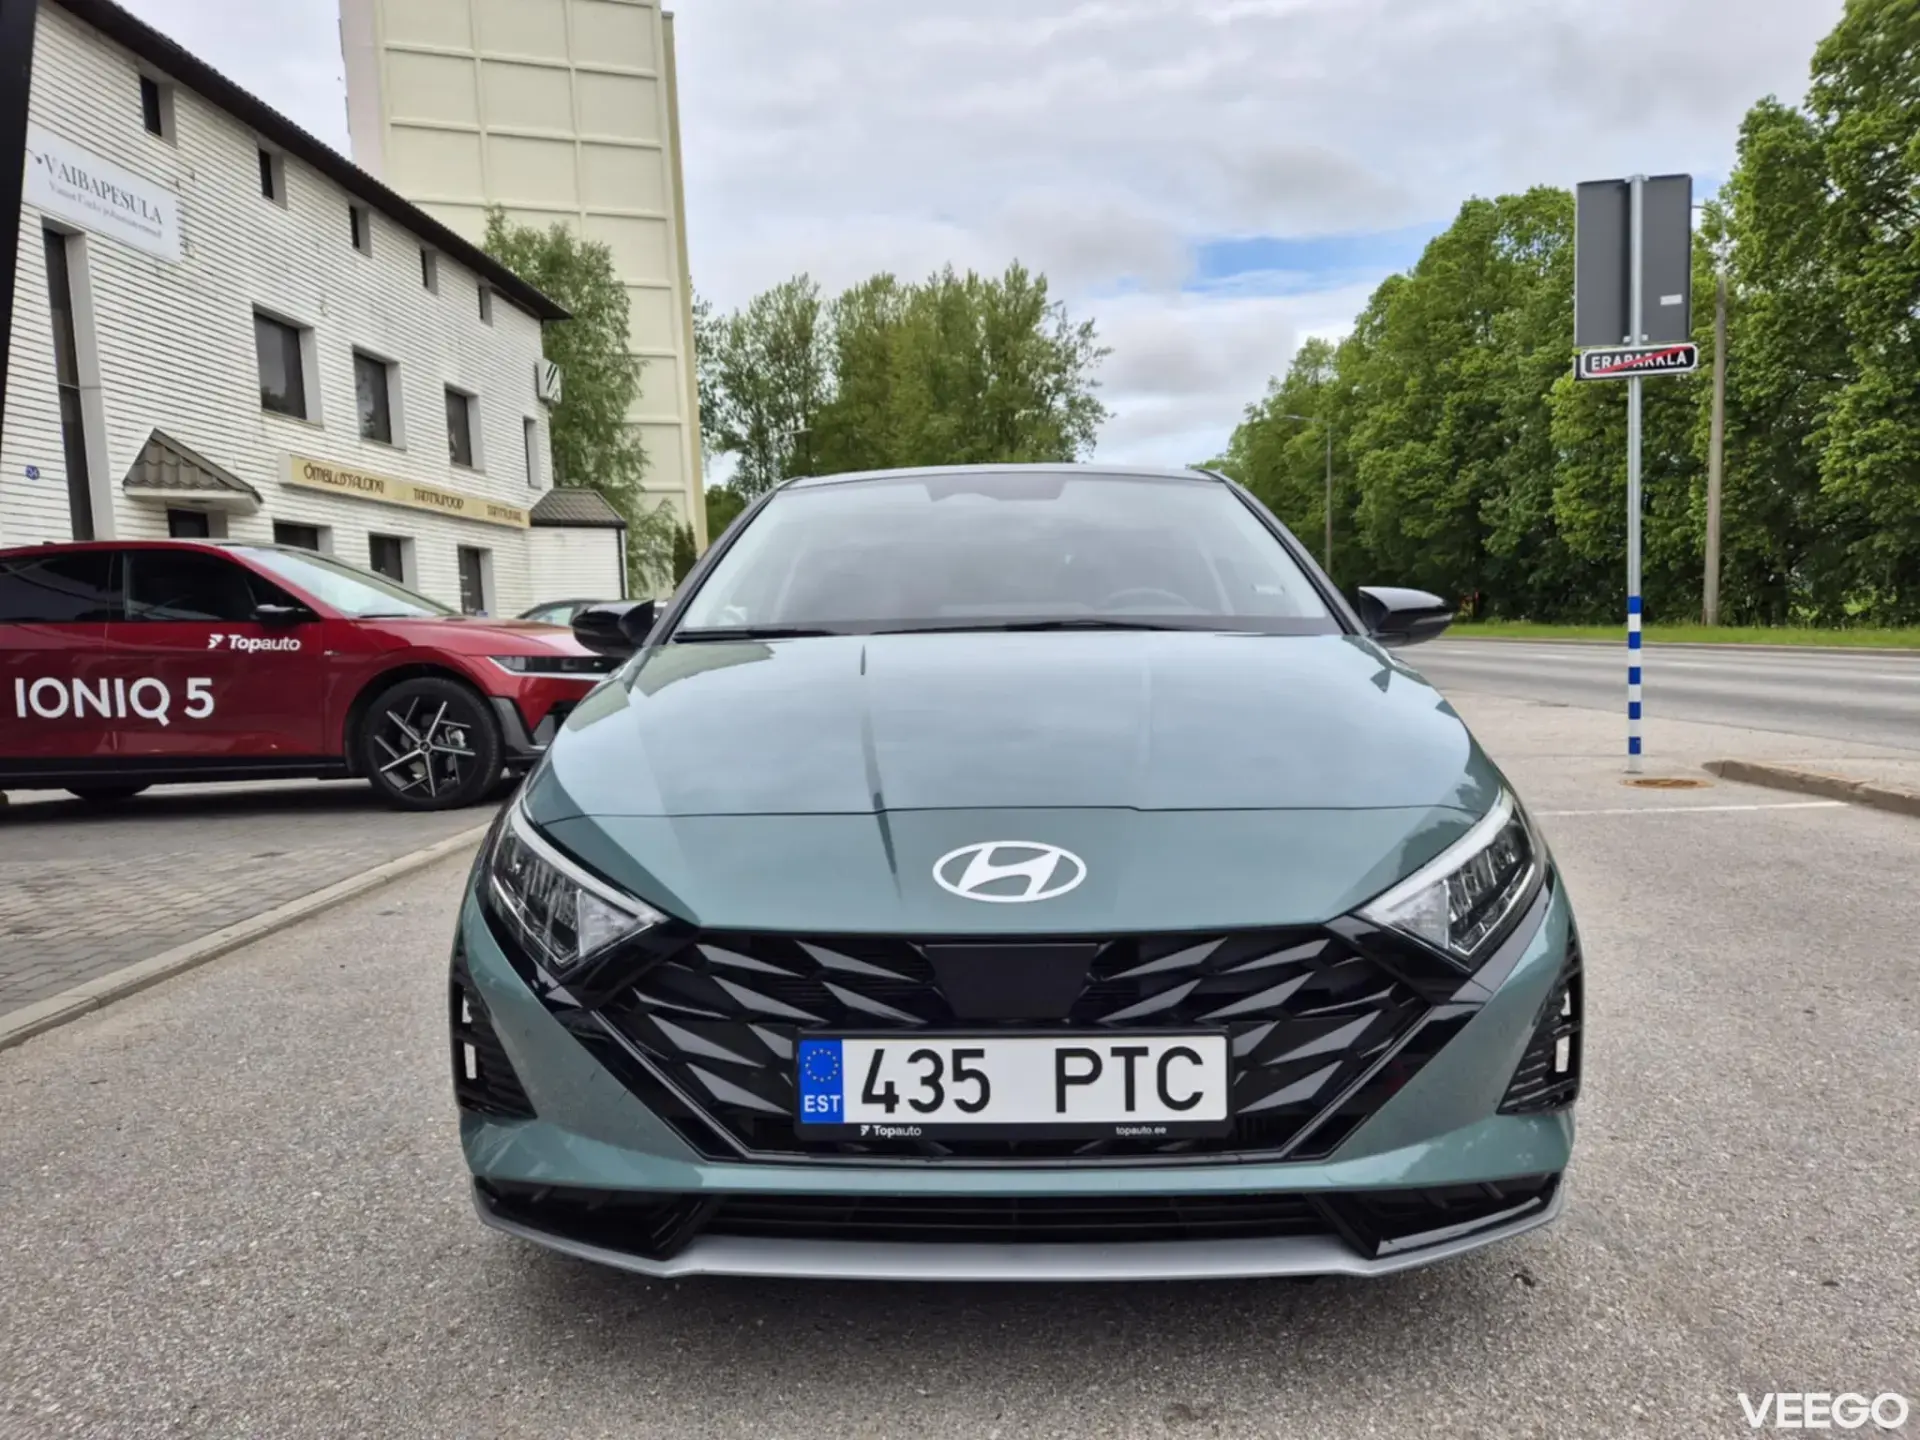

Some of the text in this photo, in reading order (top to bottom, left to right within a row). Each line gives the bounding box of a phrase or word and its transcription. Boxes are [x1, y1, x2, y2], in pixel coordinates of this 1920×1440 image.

[44, 153, 162, 225] VAIBAPESULA
[228, 634, 301, 653] Topauto
[15, 677, 214, 726] IONIQ 5
[804, 1046, 1204, 1114] EST 435 PTC
[873, 1125, 922, 1138] Topauto
[1115, 1125, 1168, 1137] topauto.ee
